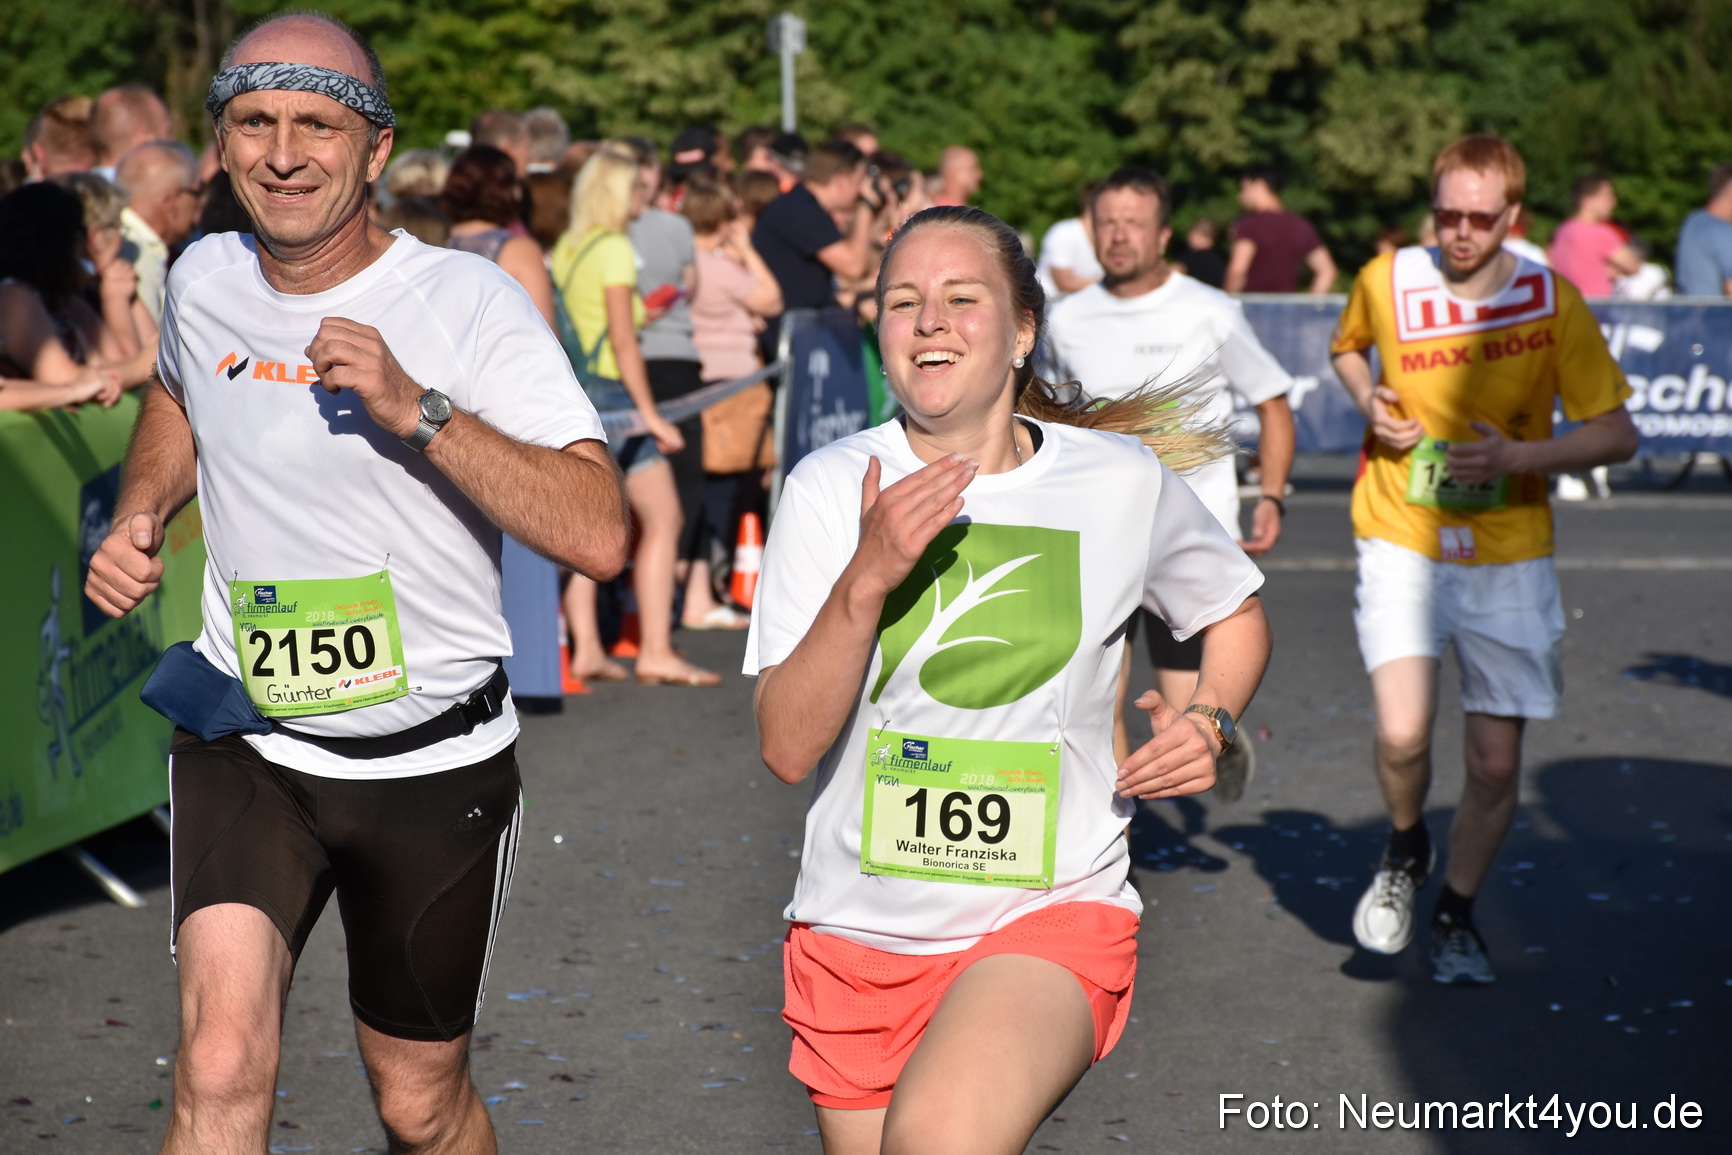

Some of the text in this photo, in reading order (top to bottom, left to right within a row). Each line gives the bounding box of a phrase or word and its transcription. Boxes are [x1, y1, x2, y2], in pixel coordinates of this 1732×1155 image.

[1401, 346, 1472, 373] MAX
[247, 601, 298, 613] firmenlauf
[305, 611, 335, 622] 2018
[249, 625, 376, 677] 2150
[355, 669, 401, 686] KLEBL
[267, 684, 336, 703] Günter
[890, 754, 953, 773] firmenlauf
[960, 773, 995, 785] 2018
[905, 788, 1011, 844] 169
[896, 839, 1017, 861] Walter Franziska
[922, 857, 987, 872] Bionorica SE
